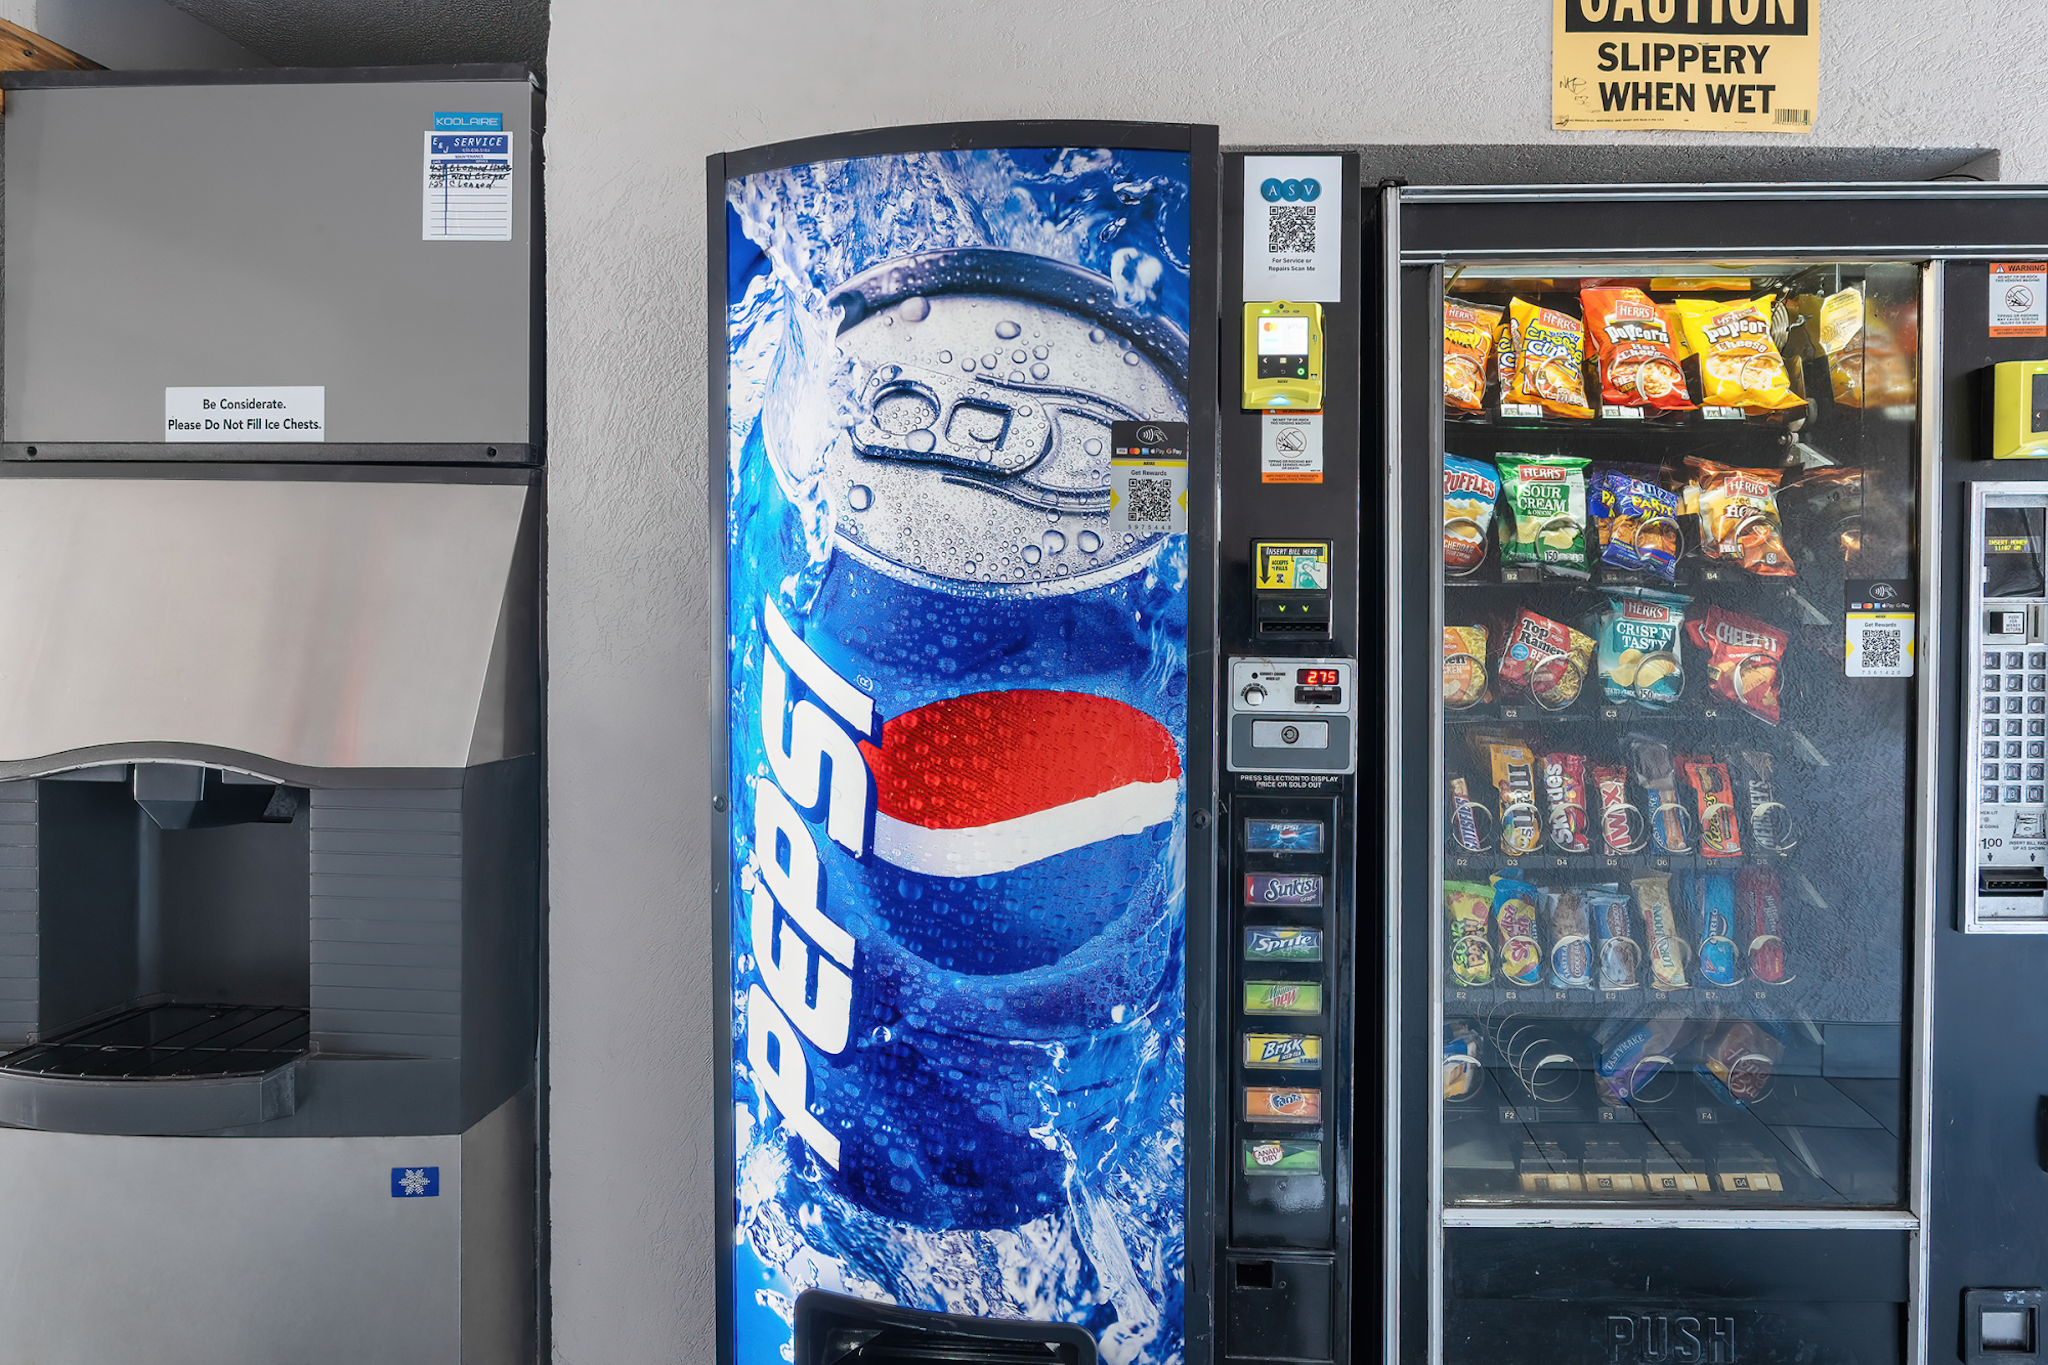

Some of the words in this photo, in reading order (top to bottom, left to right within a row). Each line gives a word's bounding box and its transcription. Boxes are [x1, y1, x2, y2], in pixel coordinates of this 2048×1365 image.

[1597, 42, 1770, 74] SLIPPERY
[1599, 82, 1696, 112] WHEN
[1705, 84, 1776, 114] WET
[436, 118, 498, 126] KOOLAIRE
[454, 137, 503, 146] SERVICE
[1620, 306, 1650, 318] HERR'S
[1543, 312, 1578, 331] HERR'S
[1715, 339, 1768, 353] Cheese
[203, 399, 216, 410] Be
[220, 398, 286, 410] Considerate.
[168, 419, 201, 430] Please
[205, 420, 220, 430] Do
[224, 419, 244, 430] Not
[247, 419, 261, 430] Fill
[265, 419, 280, 429] Ice
[283, 418, 322, 429] Chests.
[1523, 468, 1561, 479] HERR'S
[1522, 485, 1562, 498] SOUR
[1730, 481, 1765, 495] HERR'S
[1518, 497, 1566, 512] CREAM
[1632, 496, 1673, 516] PARTY
[1266, 547, 1286, 555] INSERT
[1544, 551, 1558, 561] 150
[1628, 602, 1664, 618] HERR'S
[1522, 617, 1550, 640] Top
[1518, 630, 1566, 655] Ramen
[1622, 635, 1667, 650] TASTY
[1705, 710, 1716, 718] C4
[1454, 797, 1480, 850] SATISFIES
[1603, 786, 1632, 855] TWX
[747, 592, 876, 1171] PEPSI
[1264, 878, 1318, 902] Sunkist
[1709, 908, 1719, 945] OREO
[1255, 934, 1312, 952] Sprite
[1604, 1033, 1646, 1070] TASTYKAKE
[1272, 1094, 1302, 1108] Fanta
[1504, 1111, 1515, 1120] F2
[1603, 1112, 1613, 1120] F3
[1702, 1112, 1712, 1120] F4
[1252, 1146, 1284, 1159] CANADA
[1262, 1154, 1278, 1163] DRY
[1598, 1177, 1612, 1188] G2
[1662, 1177, 1675, 1188] G3
[1735, 1177, 1748, 1188] G4
[1606, 1315, 1736, 1364] PUSH
